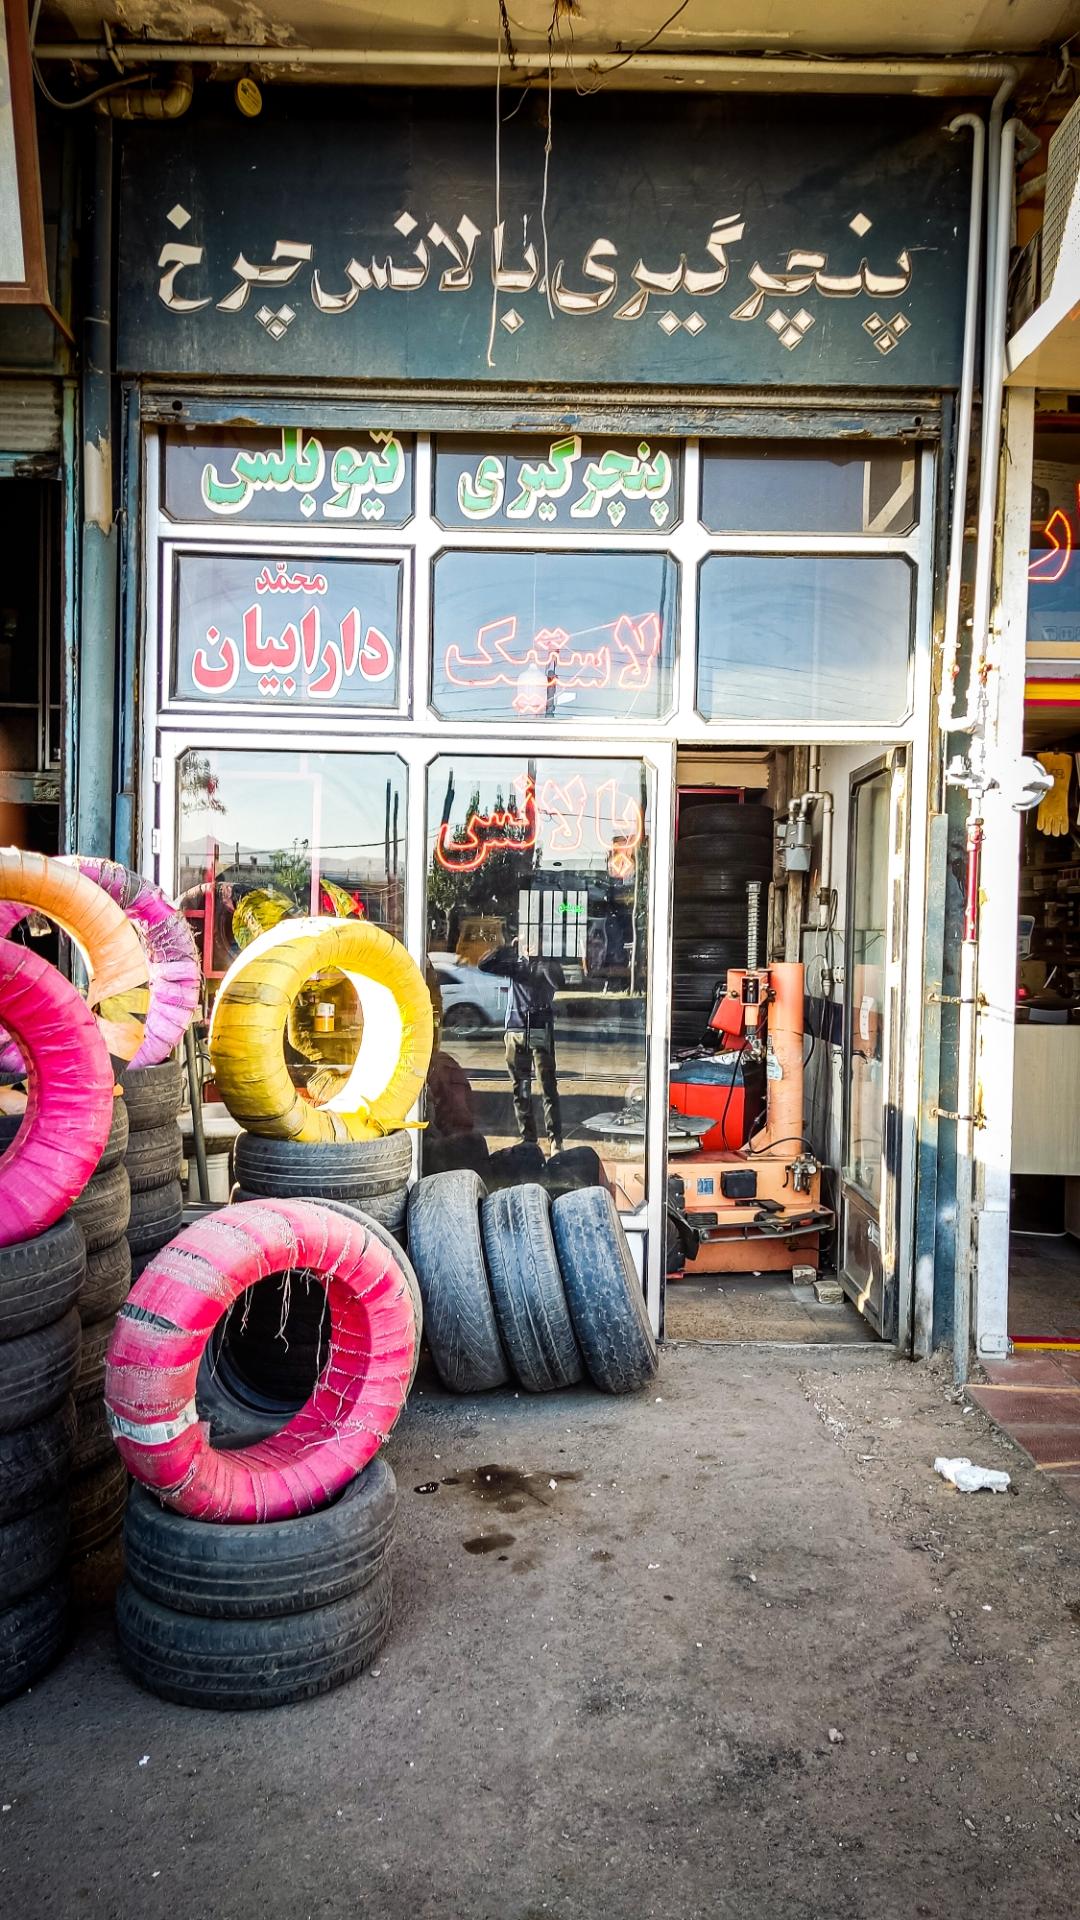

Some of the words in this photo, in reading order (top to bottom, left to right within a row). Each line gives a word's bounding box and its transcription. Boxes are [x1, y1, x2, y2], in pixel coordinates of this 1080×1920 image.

[157, 203, 313, 341] چرخ
[310, 211, 539, 335] بالانس
[191, 603, 395, 698] دارابیان
[445, 611, 661, 713] لاستیک
[436, 772, 643, 880] بالانس
